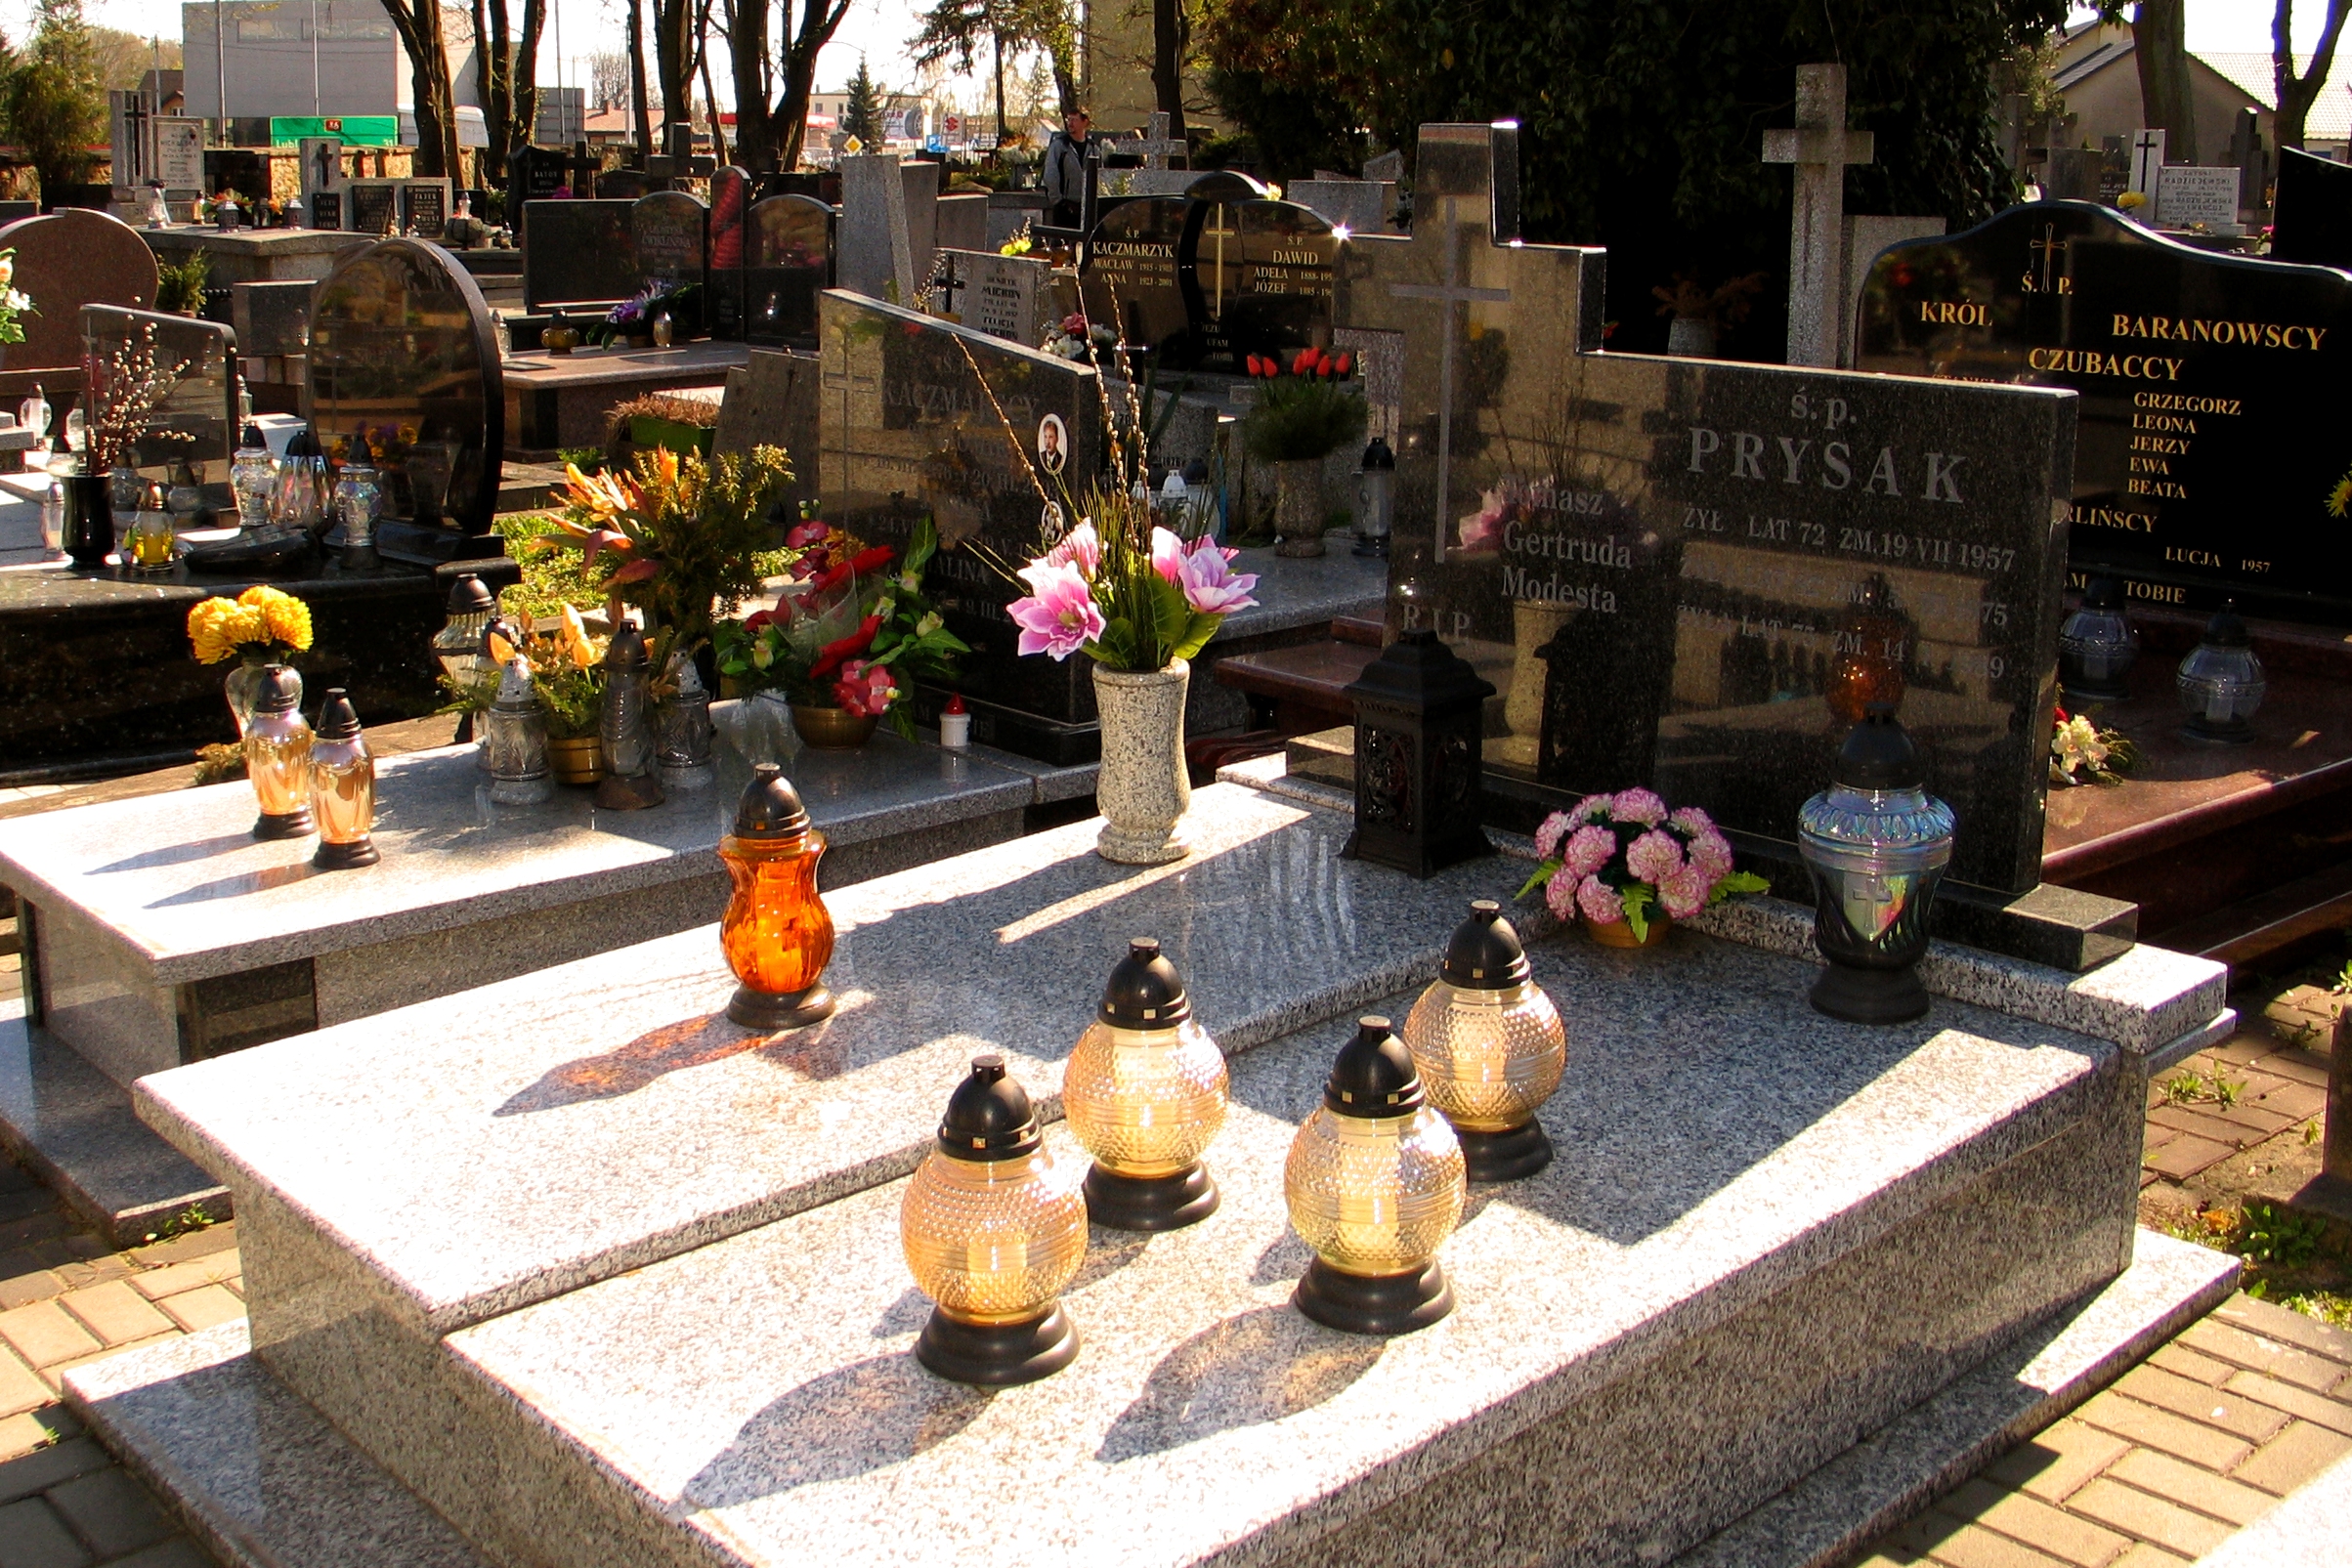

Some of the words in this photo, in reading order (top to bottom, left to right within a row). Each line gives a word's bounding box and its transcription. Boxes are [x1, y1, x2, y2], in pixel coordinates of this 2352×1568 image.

[1092, 241, 1174, 258] KACZMARZYK
[1272, 250, 1319, 265] DAWID
[1093, 258, 1134, 271] WACŁAW
[1254, 266, 1289, 279] ADELA
[1254, 279, 1287, 294] JÓZEF
[2058, 275, 2073, 294] P.
[1920, 298, 1993, 327] KRÓL
[1206, 337, 1229, 348] UFAM
[2111, 314, 2329, 352] BARANOWSCY
[2028, 347, 2185, 382] CZUBACCY
[1823, 396, 1858, 430] p.
[2133, 392, 2242, 416] GRZEGORZ
[2132, 413, 2198, 435] LEONA
[2129, 435, 2192, 455] JERZY
[1687, 427, 1967, 504] PRYSAK
[2129, 456, 2170, 476] EWA
[2127, 478, 2187, 500] BEATA
[1503, 520, 1633, 571] Gertruda
[1748, 515, 1791, 542] LAT
[1798, 522, 1826, 547] 72
[1915, 537, 1951, 564] VII
[1956, 542, 2016, 573] 1957
[2241, 559, 2271, 574] 1957
[1500, 564, 1618, 615] Modesta
[2123, 580, 2187, 605] TOBIE
[1741, 614, 1784, 642] LAT
[1831, 630, 1868, 657] ZM.
[1881, 637, 1905, 662] 14
